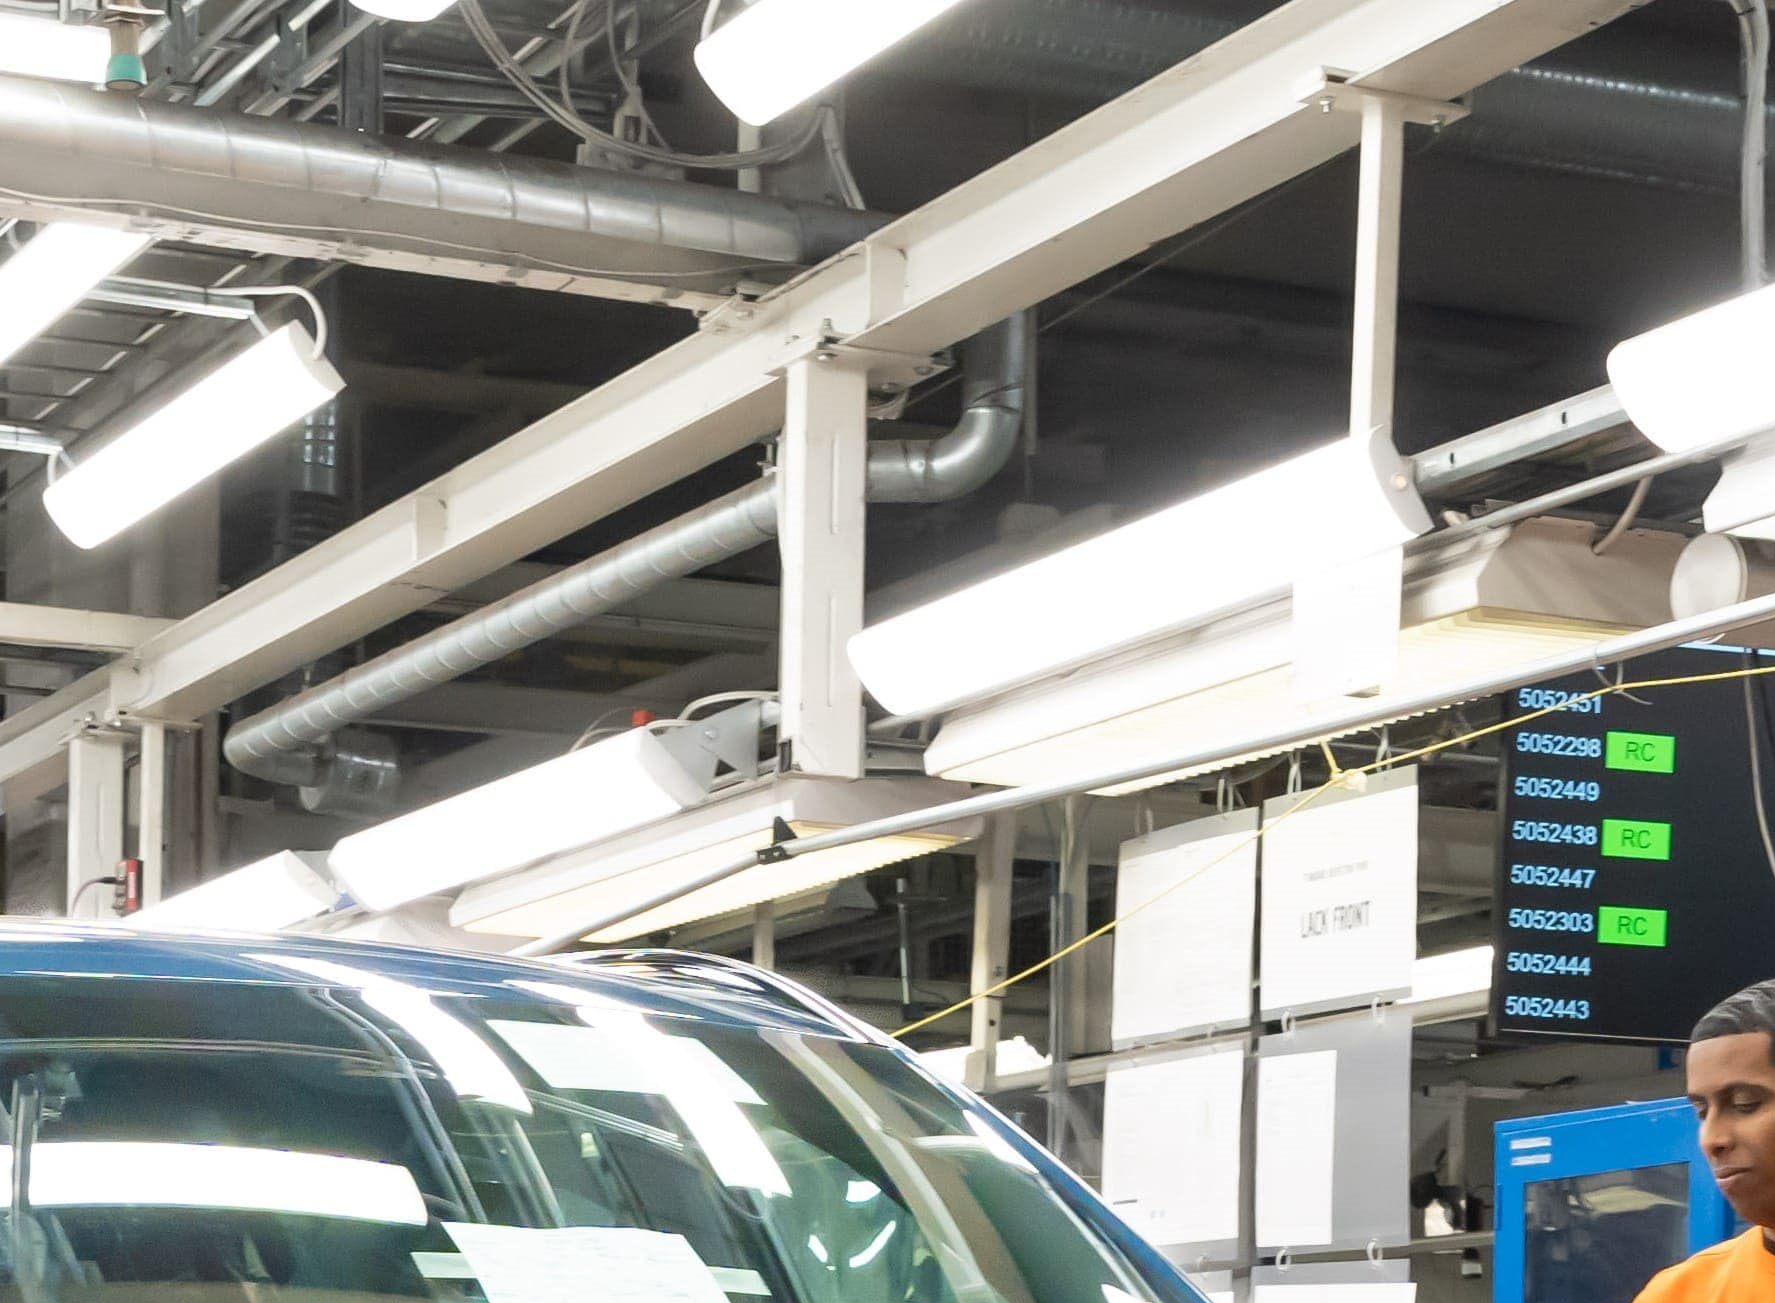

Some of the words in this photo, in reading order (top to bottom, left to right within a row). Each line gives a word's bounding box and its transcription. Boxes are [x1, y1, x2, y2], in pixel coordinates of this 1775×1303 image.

[1516, 732, 1601, 757] 5052298
[1625, 742, 1656, 762] RC
[1514, 777, 1600, 801] 5052449
[1512, 820, 1598, 845] 5052438
[1621, 829, 1652, 849] RC
[1510, 865, 1596, 888] 5052447
[1508, 909, 1594, 932] 5052303
[1617, 916, 1648, 936] RC
[1507, 952, 1592, 976] 5052444
[1505, 996, 1590, 1019] 5052443
